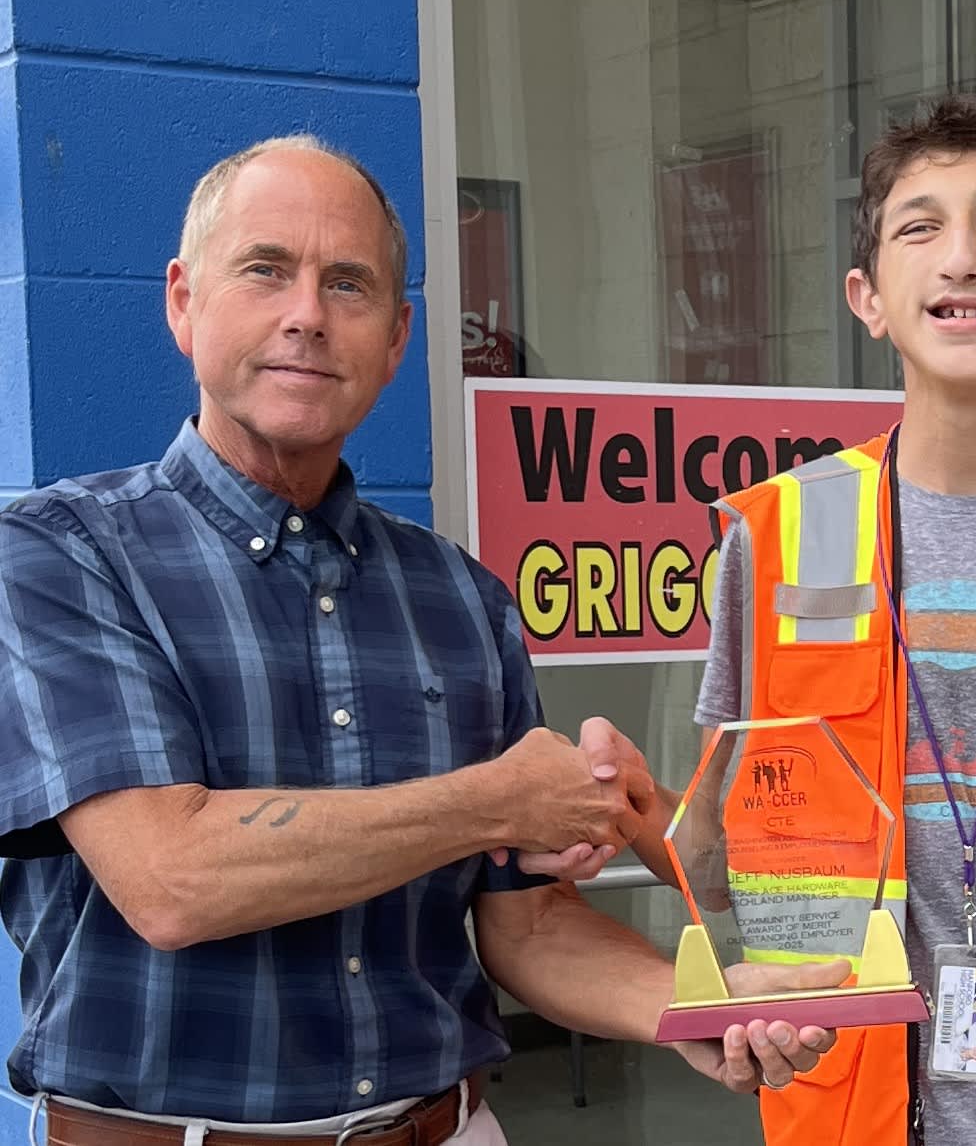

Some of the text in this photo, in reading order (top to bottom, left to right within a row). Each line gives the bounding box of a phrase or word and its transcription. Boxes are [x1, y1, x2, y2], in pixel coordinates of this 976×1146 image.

[516, 538, 720, 640] GRIG
[766, 815, 796, 827] CTE
[727, 864, 846, 884] JEFF NUSBAUM
[786, 880, 848, 892] HARDWARE
[786, 891, 839, 902] MANAGER
[736, 911, 840, 927] COMMUNITY SERVICE
[746, 921, 833, 935] AWARD OF MERIT
[727, 928, 854, 945] OUTSTANDING EMPLOYER
[778, 941, 805, 950] 2025
